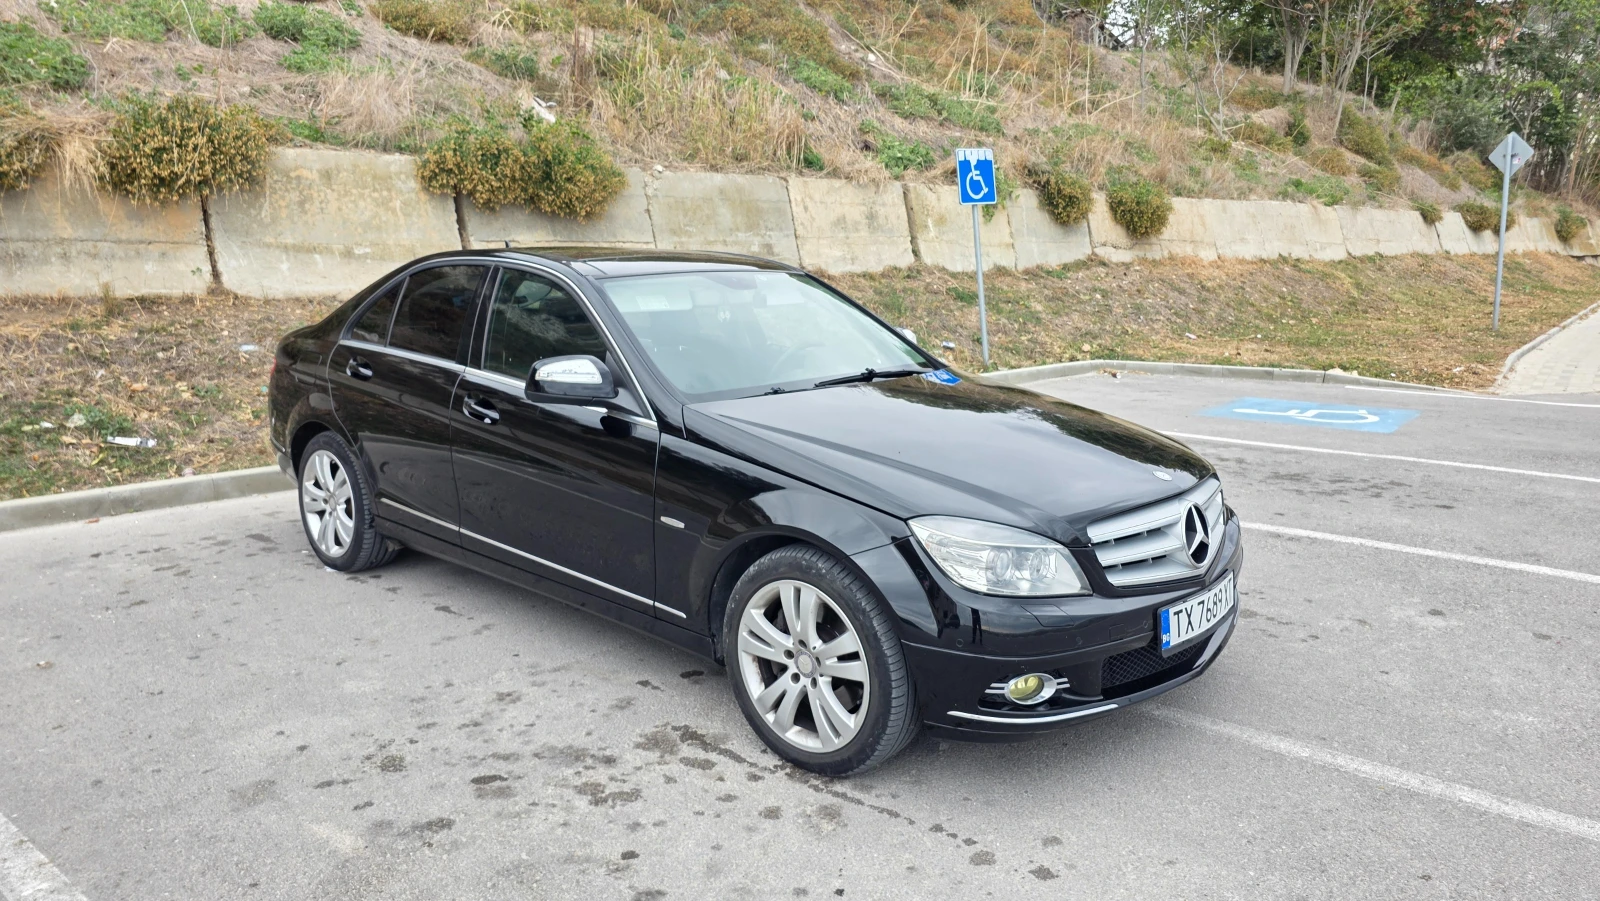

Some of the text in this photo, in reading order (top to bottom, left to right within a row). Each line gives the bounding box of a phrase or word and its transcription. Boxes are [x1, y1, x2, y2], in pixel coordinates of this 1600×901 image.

[1173, 578, 1232, 638] TX 7689 XT
[1162, 632, 1170, 644] BG
